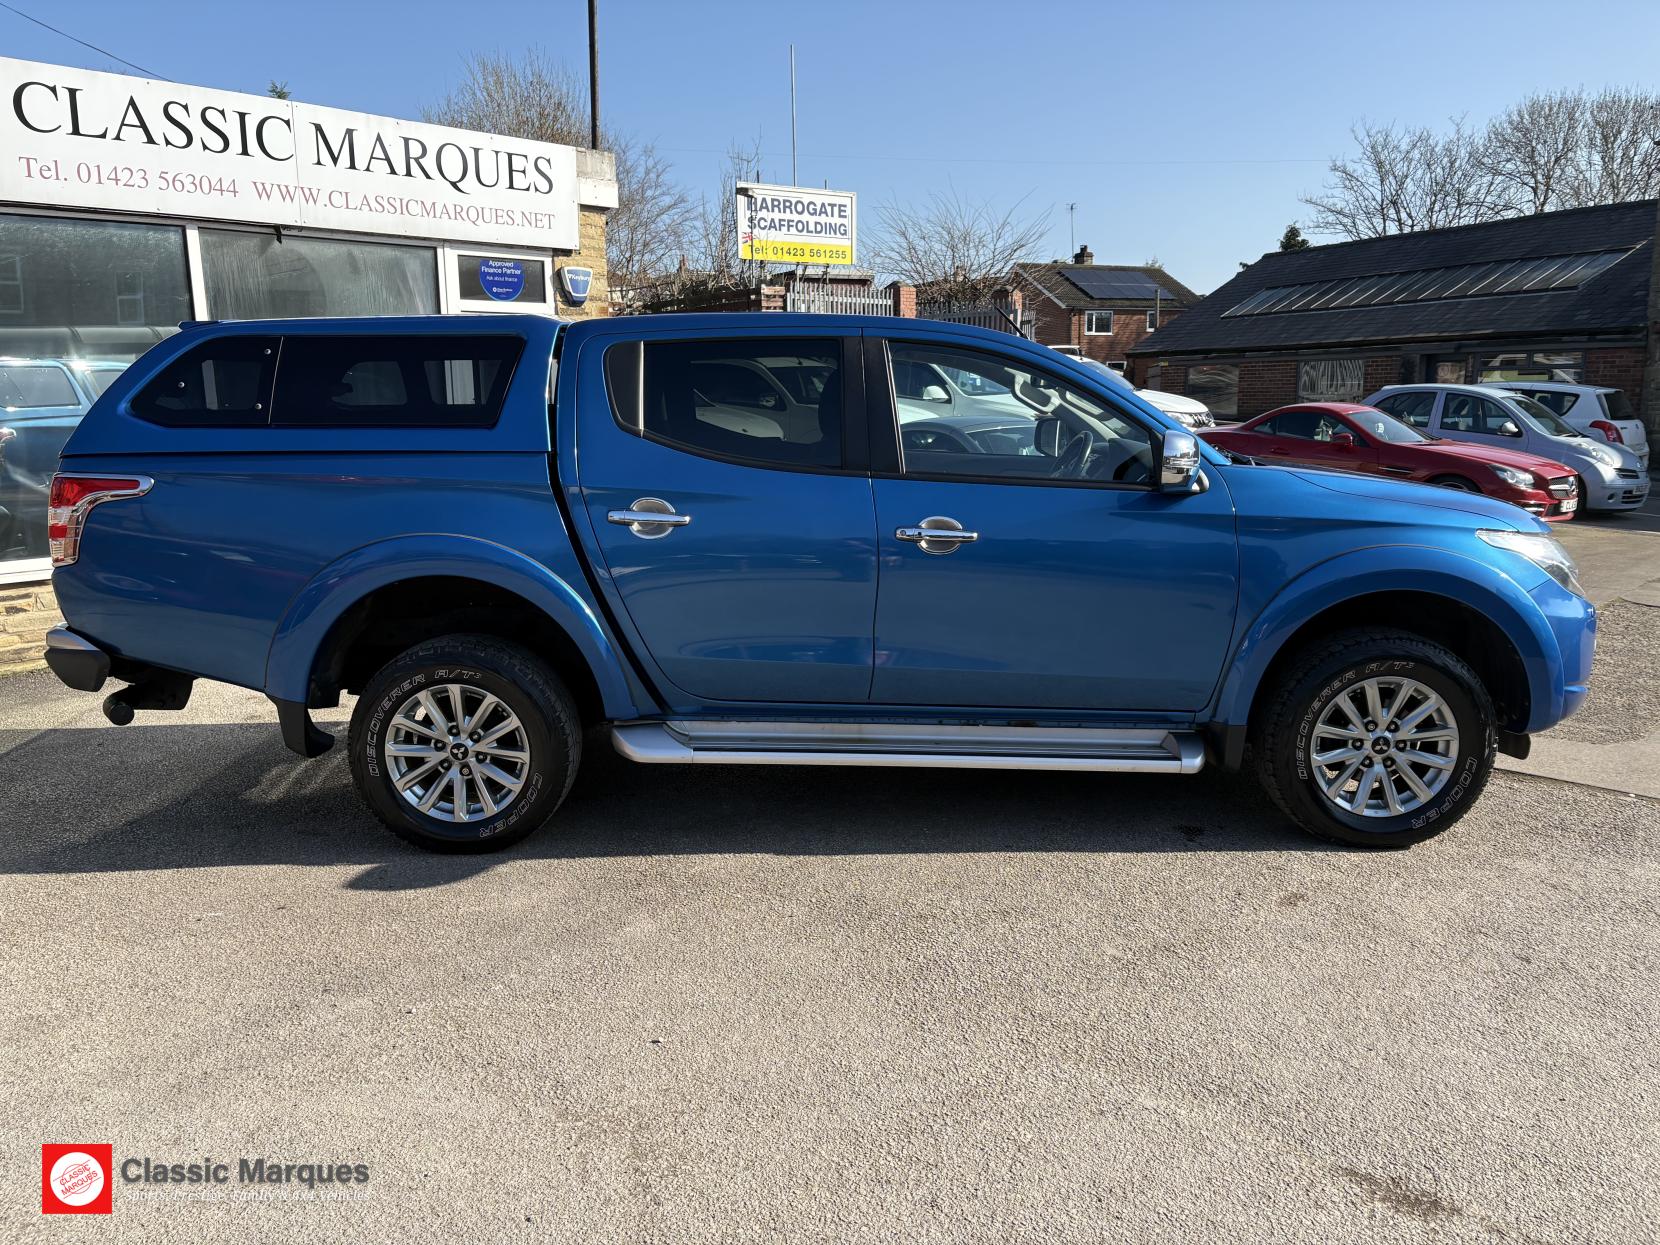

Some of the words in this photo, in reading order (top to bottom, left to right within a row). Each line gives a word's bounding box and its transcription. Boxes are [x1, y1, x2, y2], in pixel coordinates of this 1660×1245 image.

[12, 81, 294, 162] CLASSIC
[308, 121, 554, 195] MARQUES
[18, 156, 68, 182] Tel.
[76, 162, 149, 189] 01423
[158, 170, 239, 198] 563044
[252, 180, 556, 230] WWW.CLASSICMARQUES.NET
[747, 197, 848, 219] HARROGATE
[747, 217, 848, 237] SCAFFOLDING
[489, 260, 514, 268] Approved
[772, 246, 805, 257] 01423
[809, 249, 847, 260] 561255
[367, 673, 426, 777] DISCOVERER
[1295, 670, 1357, 780] DISCOVERER
[479, 772, 544, 838] COOPER
[1411, 756, 1478, 830] COOPER
